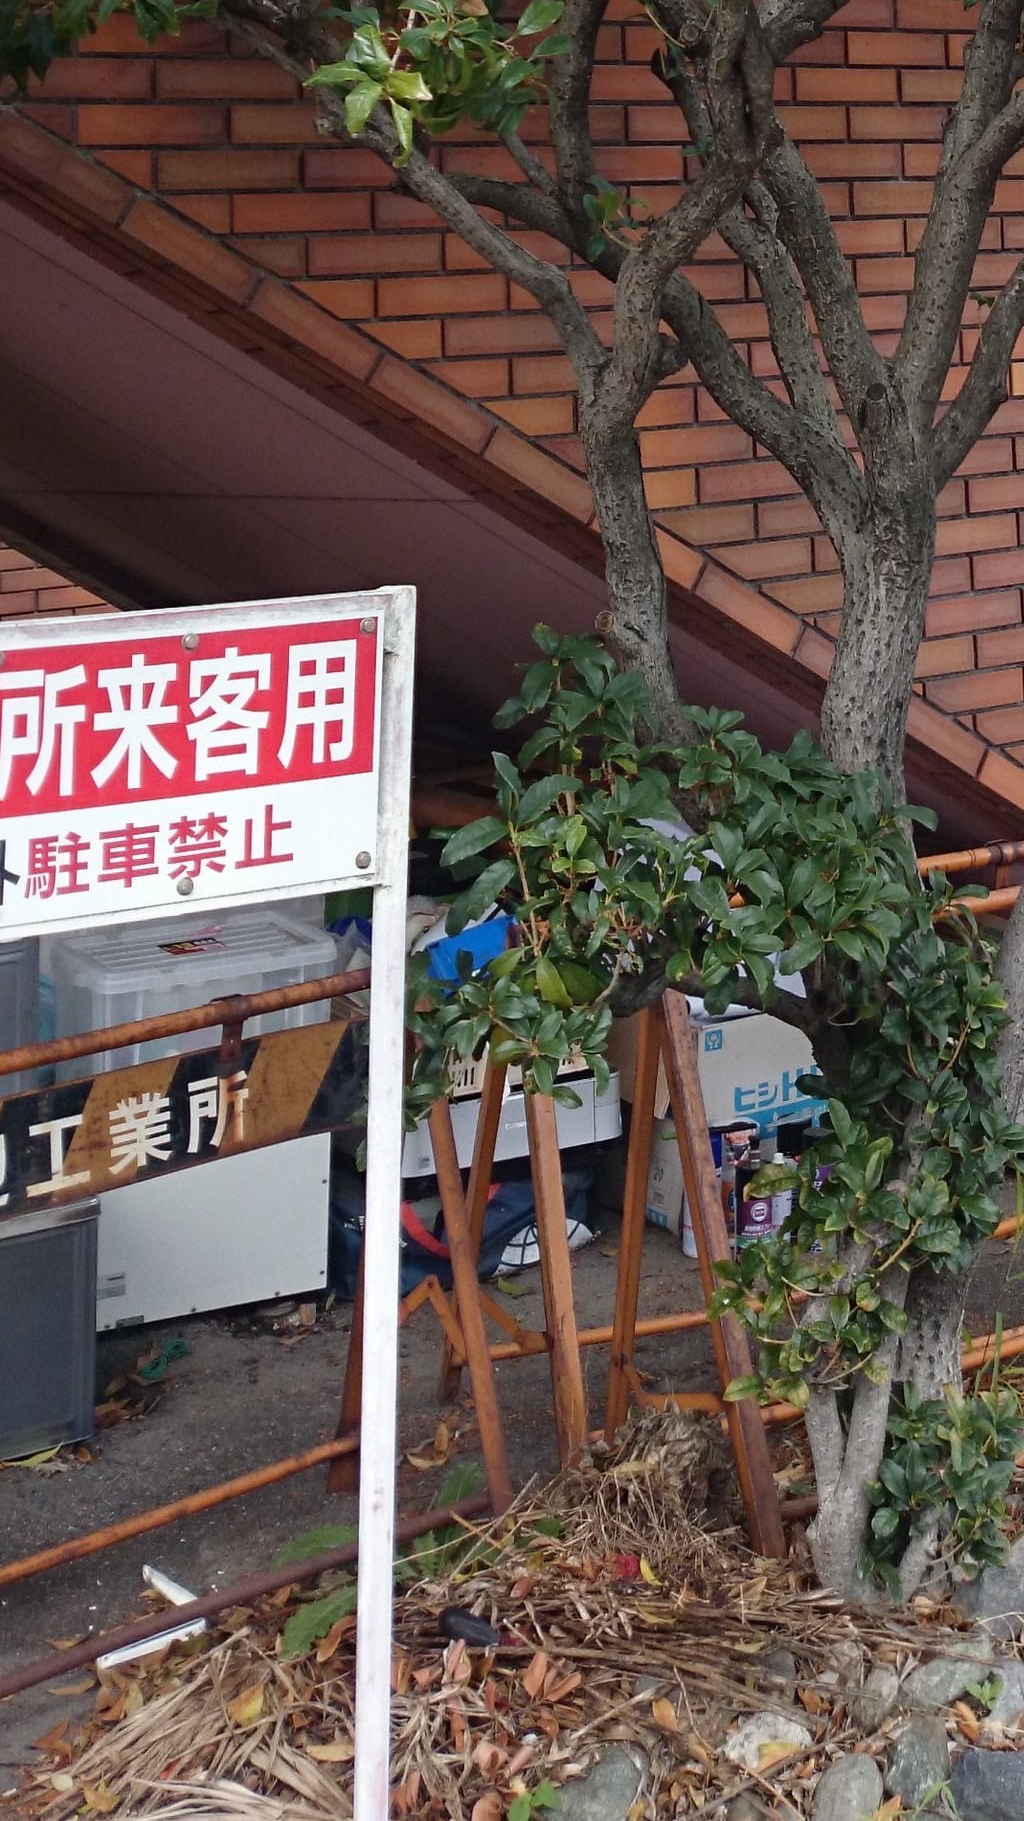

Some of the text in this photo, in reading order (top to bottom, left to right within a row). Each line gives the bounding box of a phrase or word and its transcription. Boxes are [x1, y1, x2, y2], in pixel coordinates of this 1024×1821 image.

[0, 639, 358, 801] 所来客用
[0, 1070, 249, 1207] 工業所
[735, 1064, 818, 1112] ヒシH
